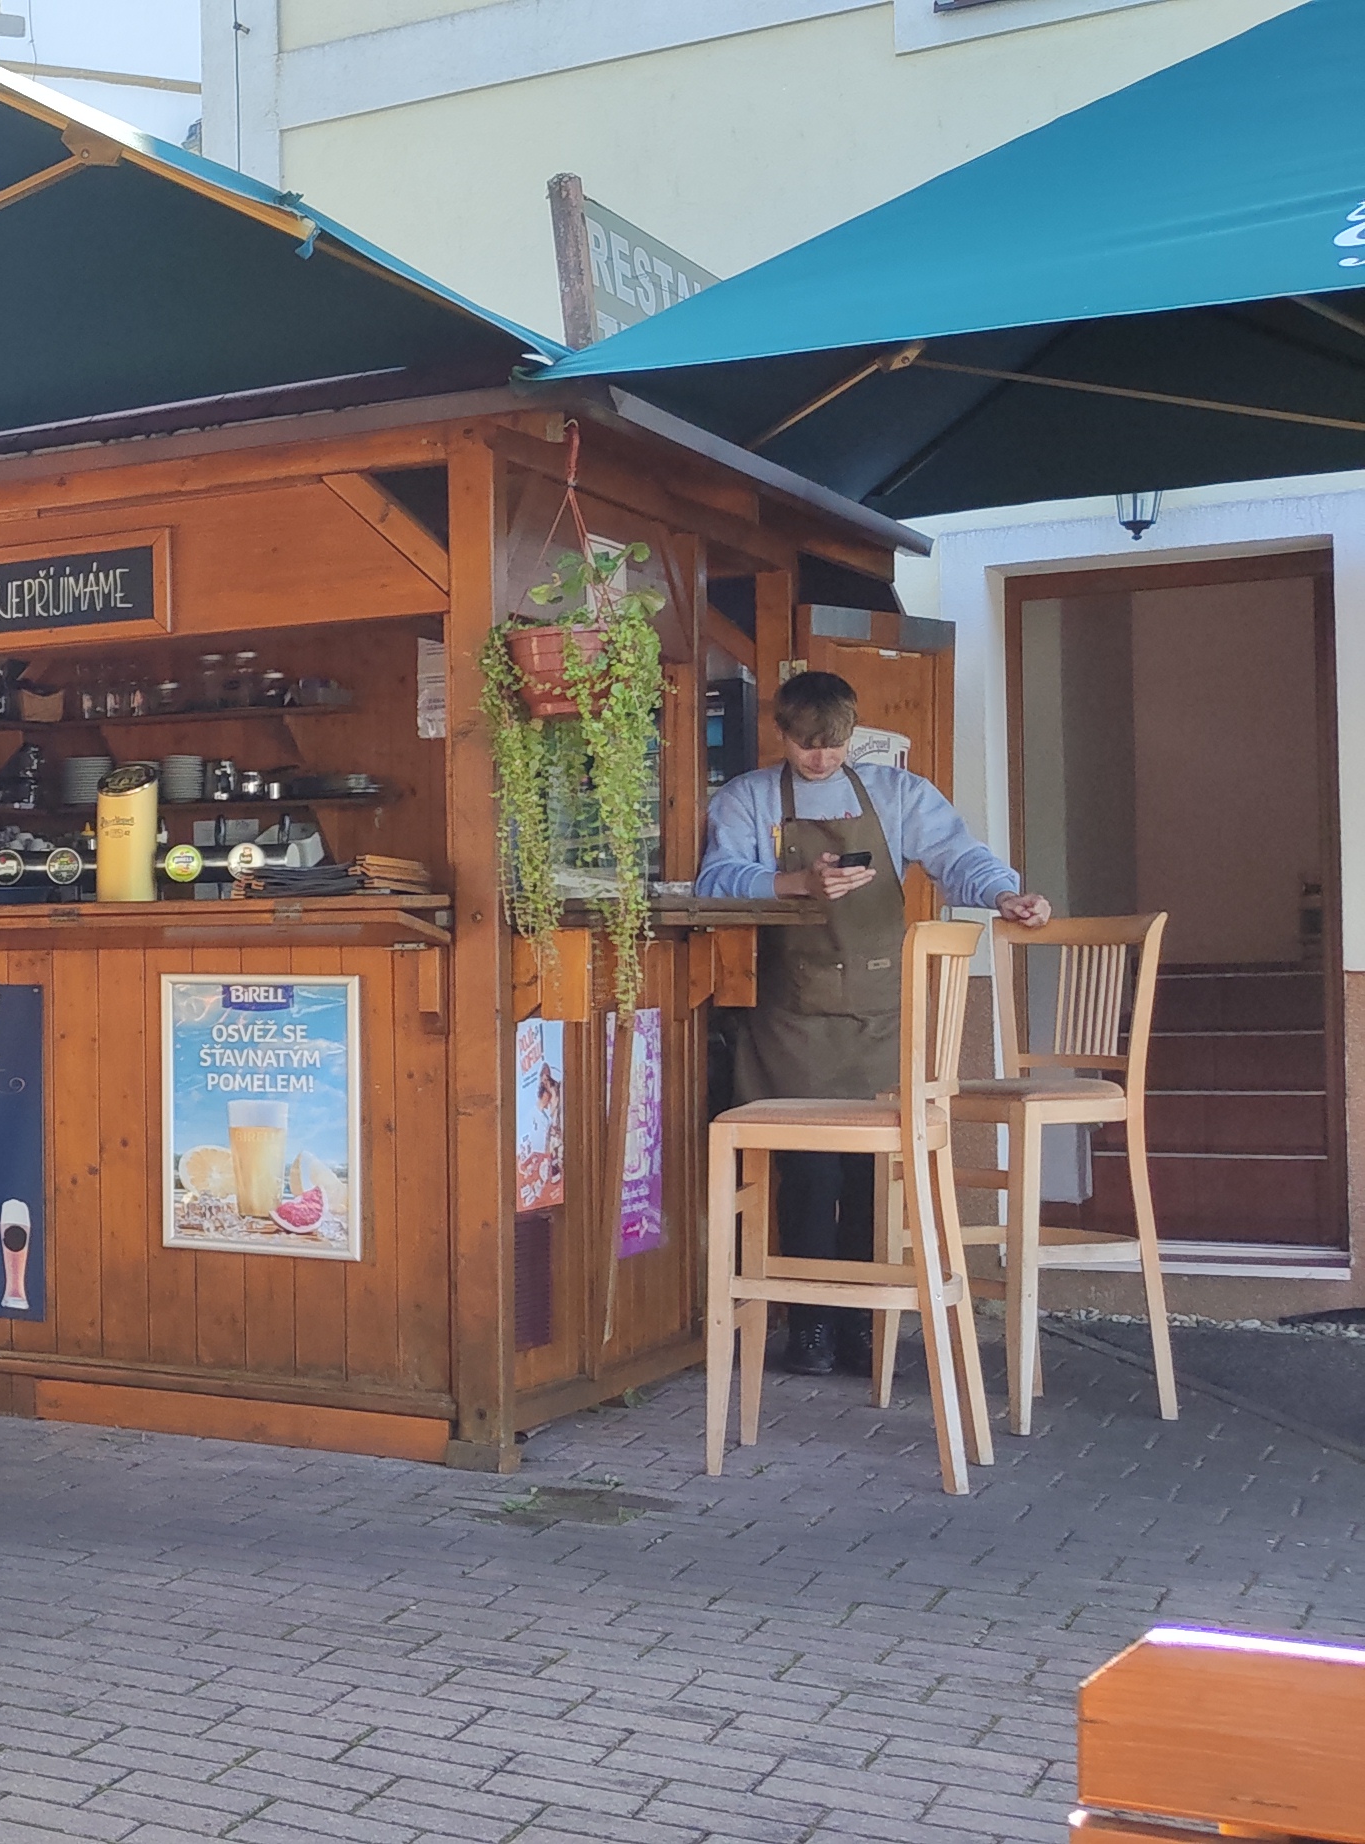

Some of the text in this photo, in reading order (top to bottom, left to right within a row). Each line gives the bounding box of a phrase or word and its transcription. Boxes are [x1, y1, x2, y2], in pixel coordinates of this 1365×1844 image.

[586, 215, 703, 317] RESTA
[212, 1020, 308, 1043] OSVĚŽ SE
[199, 1044, 321, 1068] ŠŤAVNATÝM
[207, 1072, 314, 1093] POMELEM!
